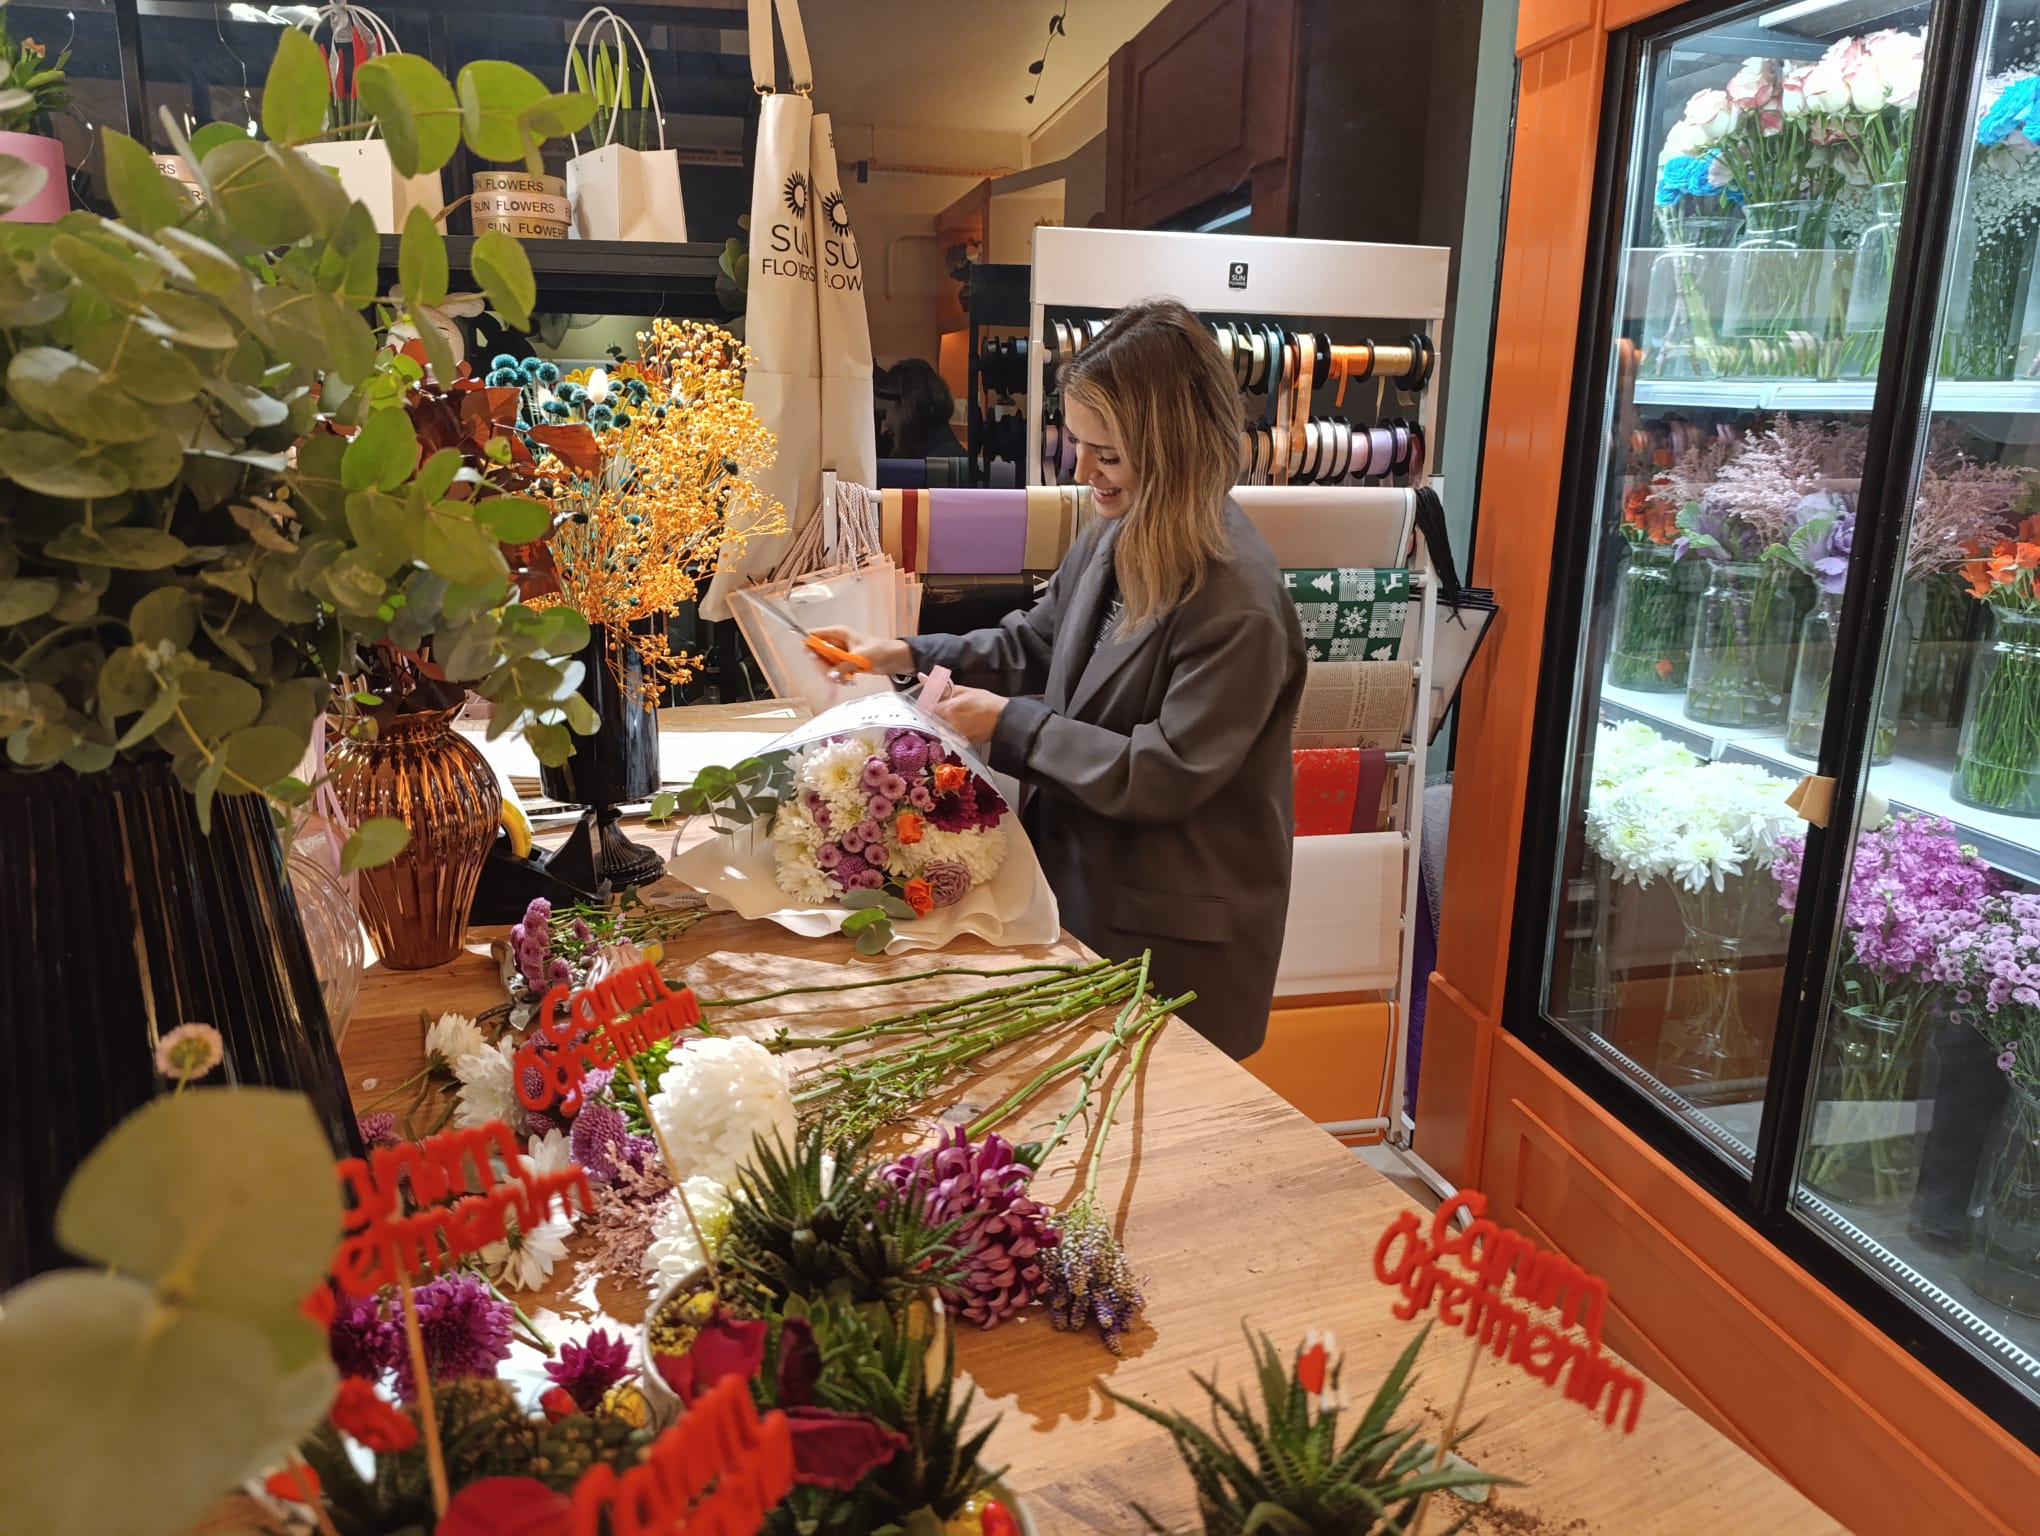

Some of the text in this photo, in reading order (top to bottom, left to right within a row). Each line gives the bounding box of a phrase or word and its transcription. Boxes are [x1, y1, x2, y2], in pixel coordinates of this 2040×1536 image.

[486, 179, 544, 192] FLOWERS
[474, 201, 490, 213] SUN
[496, 200, 555, 214] FLOWERS
[487, 222, 567, 239] SUN FLOWERS
[825, 240, 860, 269] SU
[824, 269, 862, 291] FLOW
[1231, 274, 1246, 282] SUN
